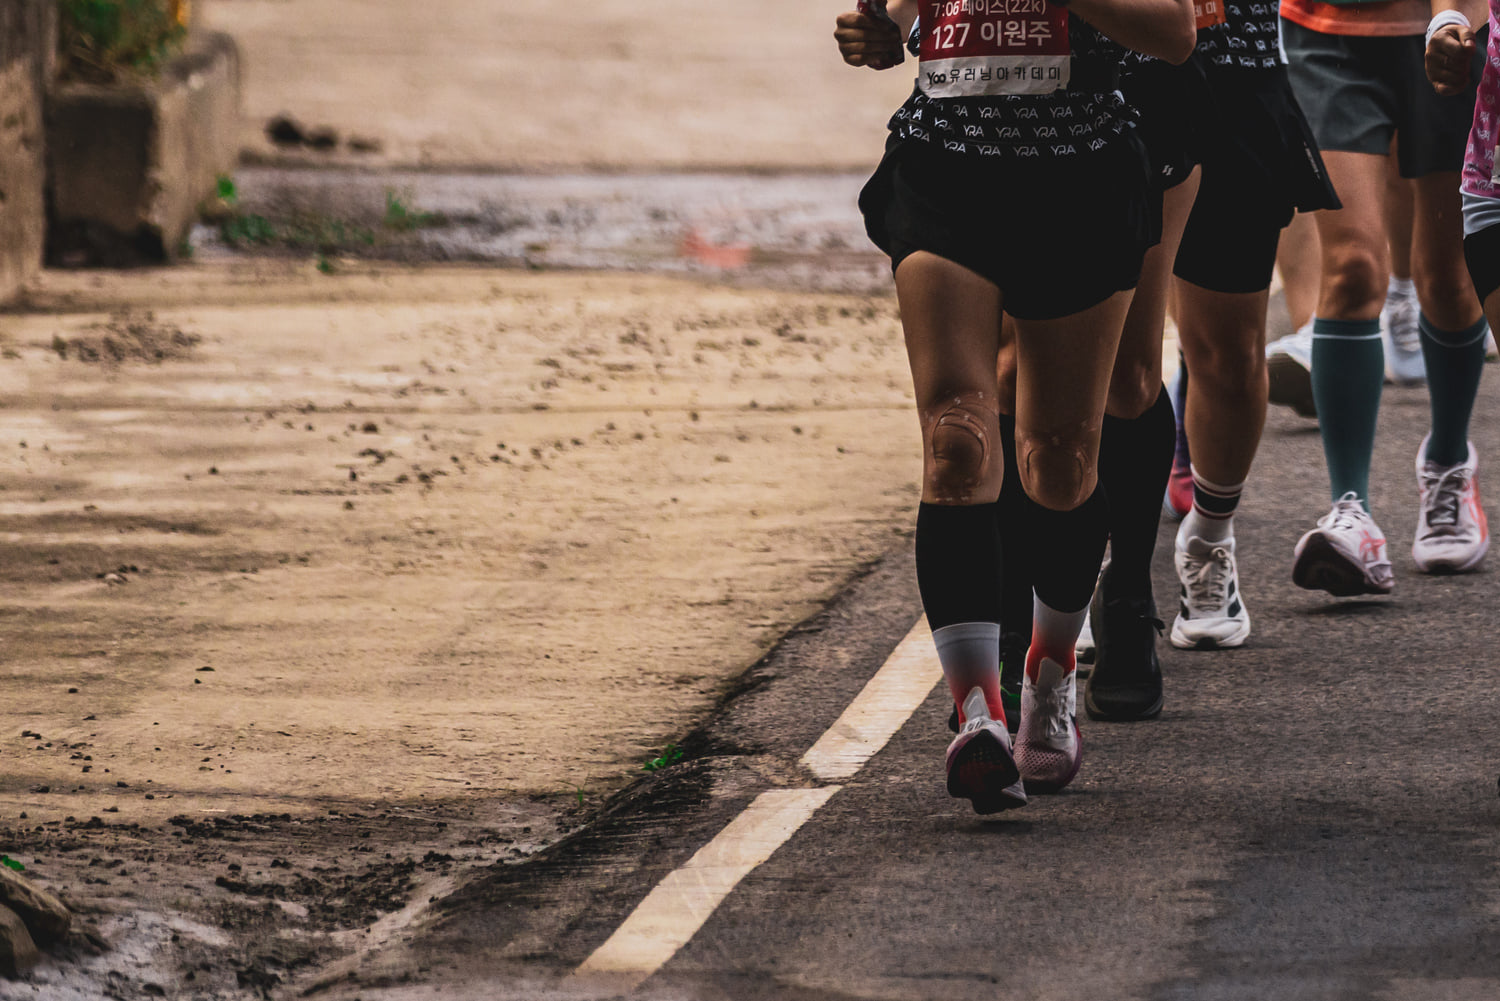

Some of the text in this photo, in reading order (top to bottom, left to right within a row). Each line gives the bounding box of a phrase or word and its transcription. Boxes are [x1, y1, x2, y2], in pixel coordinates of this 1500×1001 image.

[931, 0, 960, 18] 7:06
[932, 20, 1052, 50] 127 이원주
[927, 71, 946, 85] Yoo
[978, 106, 1073, 119] YRA YRA YRA
[963, 125, 984, 137] YRA
[996, 127, 1020, 138] YRA
[1034, 126, 1058, 138] YRA
[944, 139, 966, 153] YRA
[976, 145, 1000, 156] YRA
[1051, 145, 1076, 156] YRA
